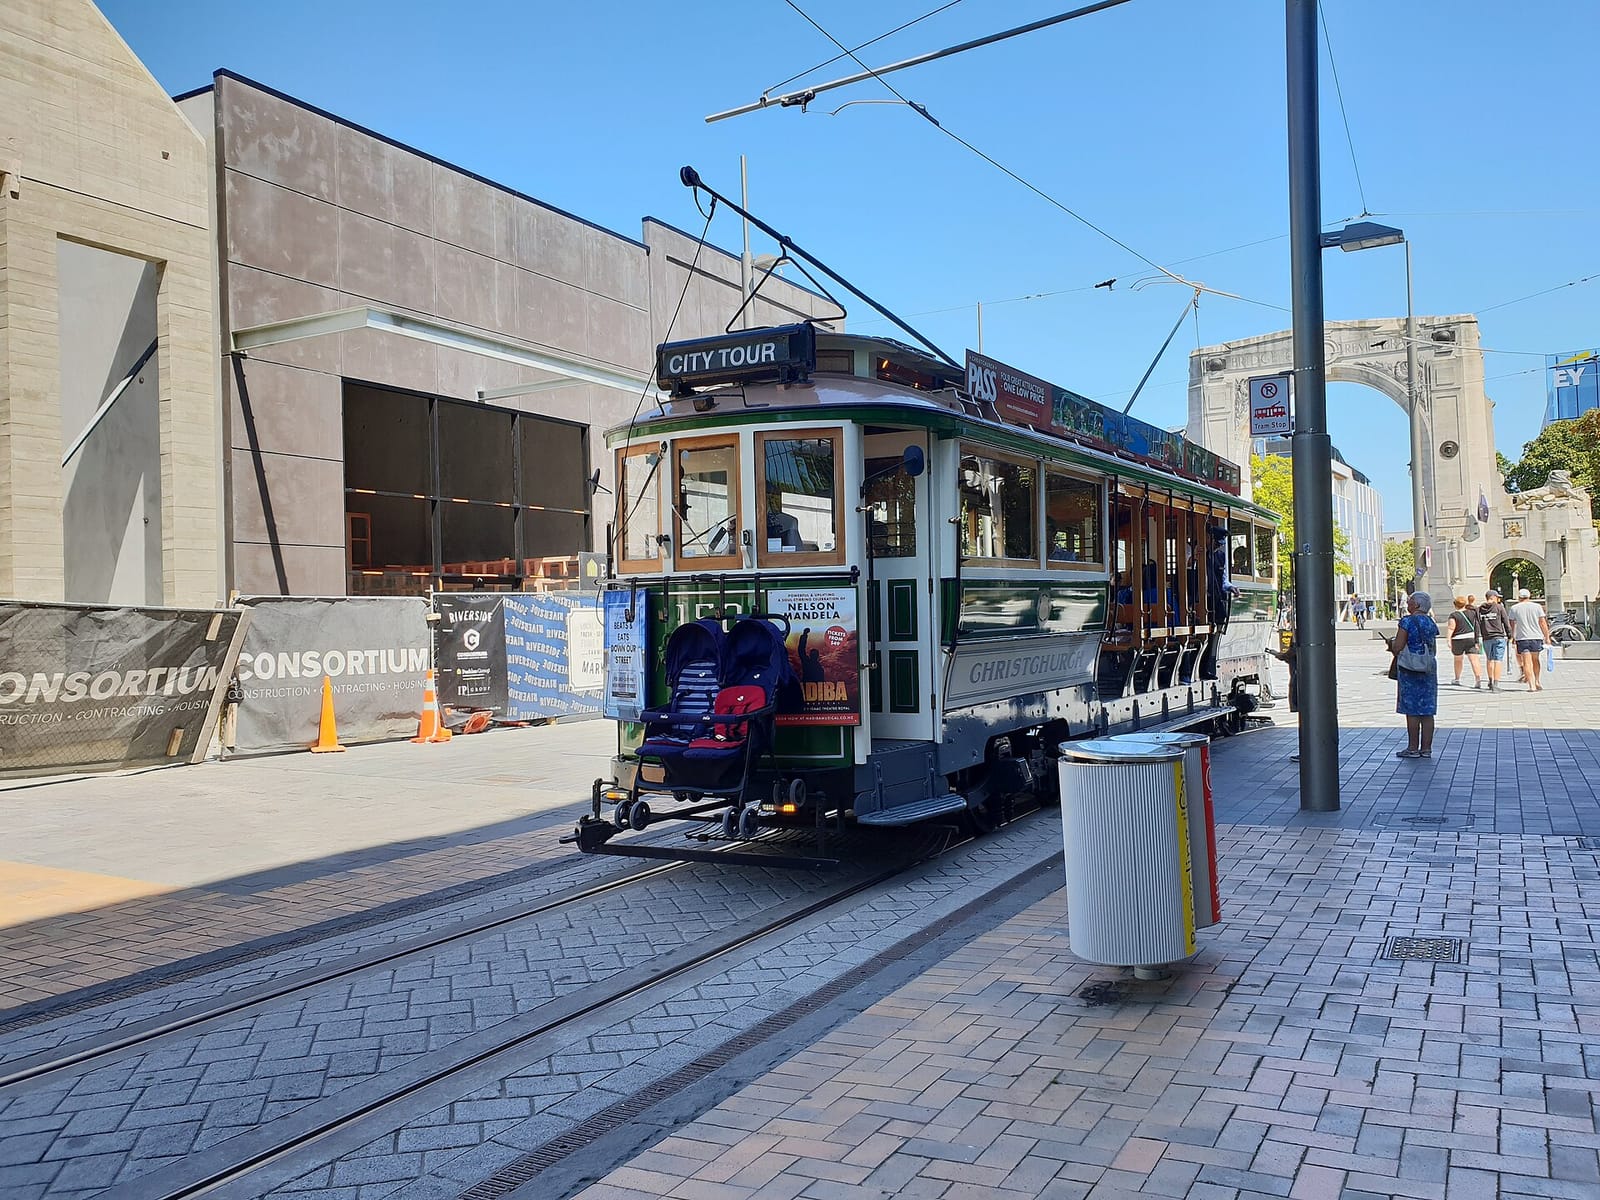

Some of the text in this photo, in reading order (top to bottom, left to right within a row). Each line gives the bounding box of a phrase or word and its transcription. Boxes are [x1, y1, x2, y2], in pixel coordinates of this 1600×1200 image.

[670, 342, 776, 374] CITY TOUR
[968, 362, 996, 402] PASS
[1554, 366, 1586, 388] EY
[1004, 382, 1045, 405] ONE LOW PRICE
[1272, 421, 1286, 429] Stop
[788, 602, 834, 611] NELSON
[448, 610, 493, 624] RIVERSIDE
[784, 611, 840, 620] MANDELA
[526, 641, 561, 658] RIVERSIDE
[238, 648, 428, 680] CONSORTIUM
[582, 660, 604, 676] MAR
[615, 656, 632, 664] STREET
[970, 651, 1084, 684] CHRISTCHURCH
[244, 686, 310, 699] NSTRUCTION
[800, 682, 847, 701] DIBA
[75, 706, 164, 722] CONTRACTING
